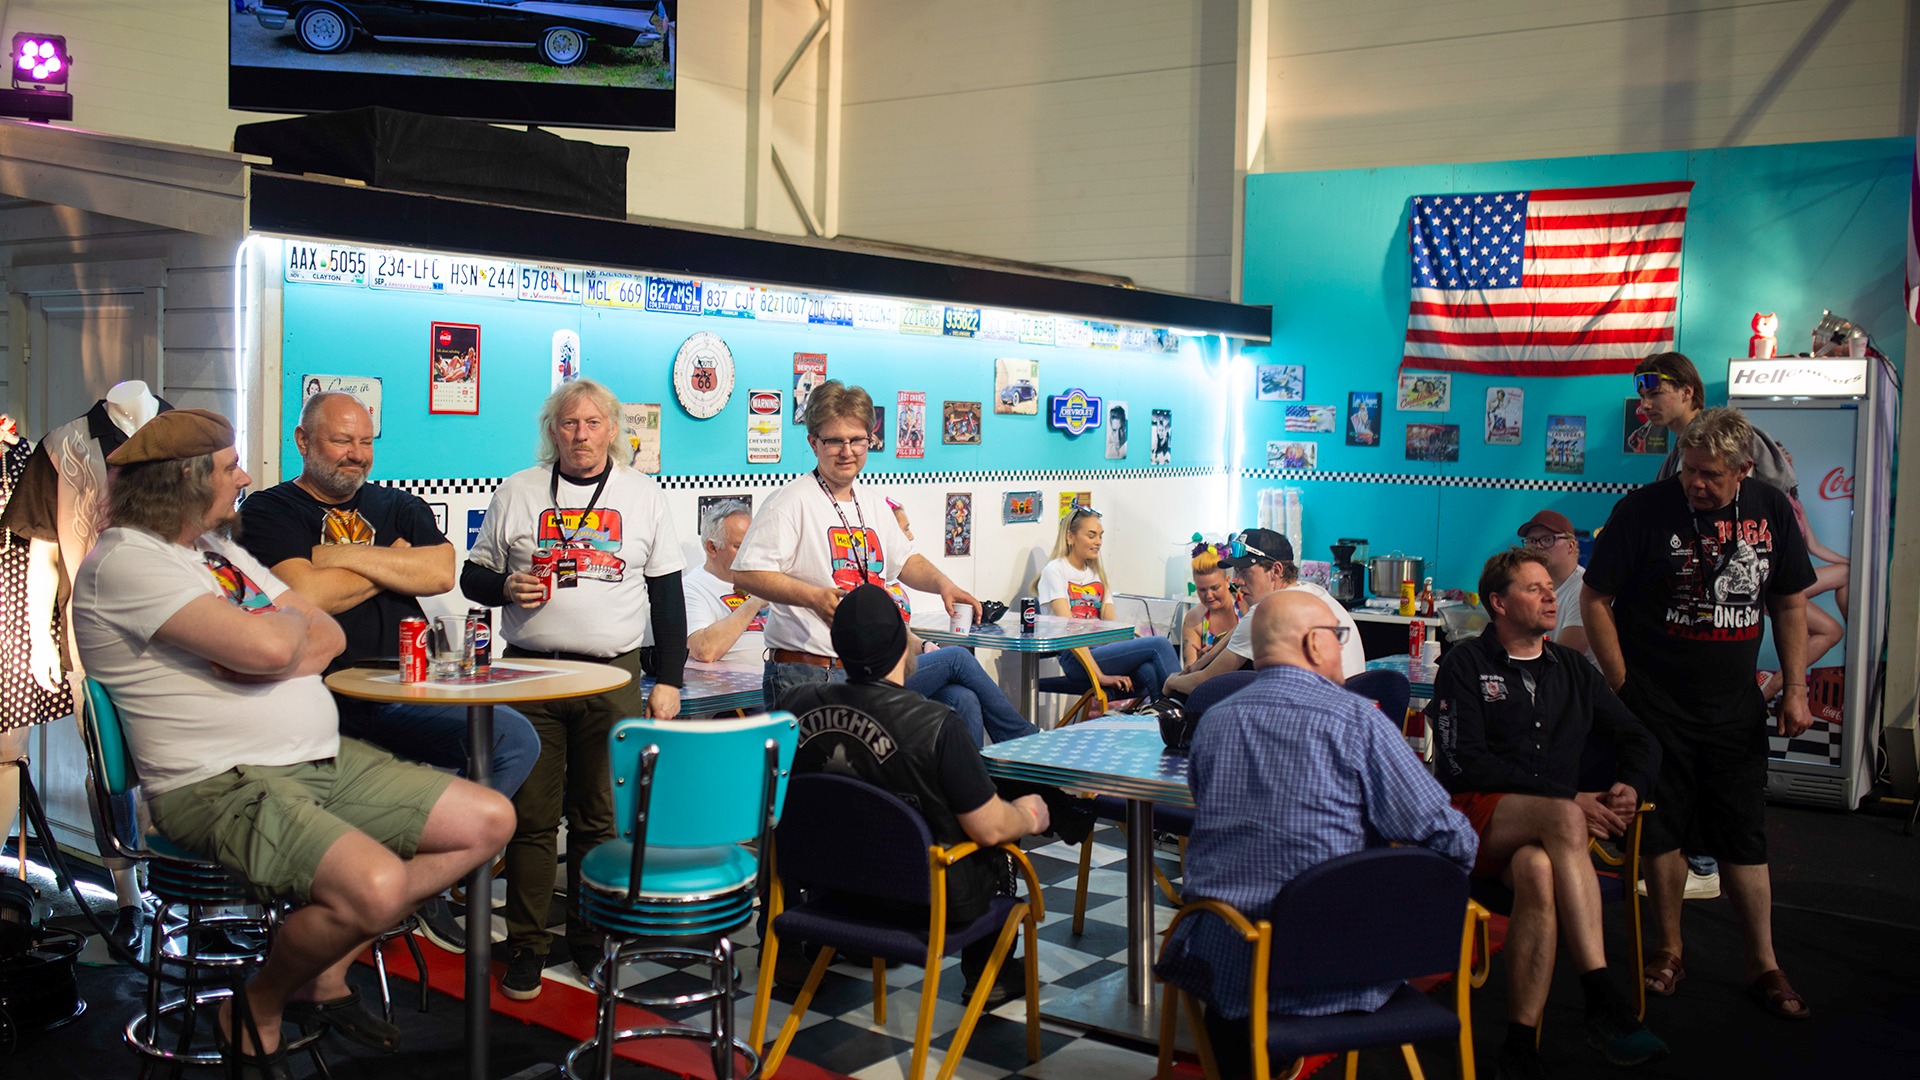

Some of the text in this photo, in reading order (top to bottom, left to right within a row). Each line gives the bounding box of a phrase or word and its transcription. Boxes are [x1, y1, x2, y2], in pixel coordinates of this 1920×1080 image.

[290, 246, 366, 275] AAX 5055
[378, 254, 440, 280] 234-LFC
[312, 273, 342, 281] CLAYTON
[374, 277, 385, 285] SEP
[450, 263, 514, 289] HSN 244
[522, 268, 580, 294] 5784 LL
[588, 279, 643, 303] MGL 669
[706, 289, 728, 308] 837
[808, 299, 825, 318] 204
[945, 310, 979, 331] 935822
[797, 364, 824, 373] SERVICE
[1734, 369, 1787, 385] Hell
[698, 375, 711, 389] 66
[752, 398, 779, 409] WARNING
[1060, 406, 1093, 417] CHEVROLET
[798, 708, 892, 756] KNIGHTS
